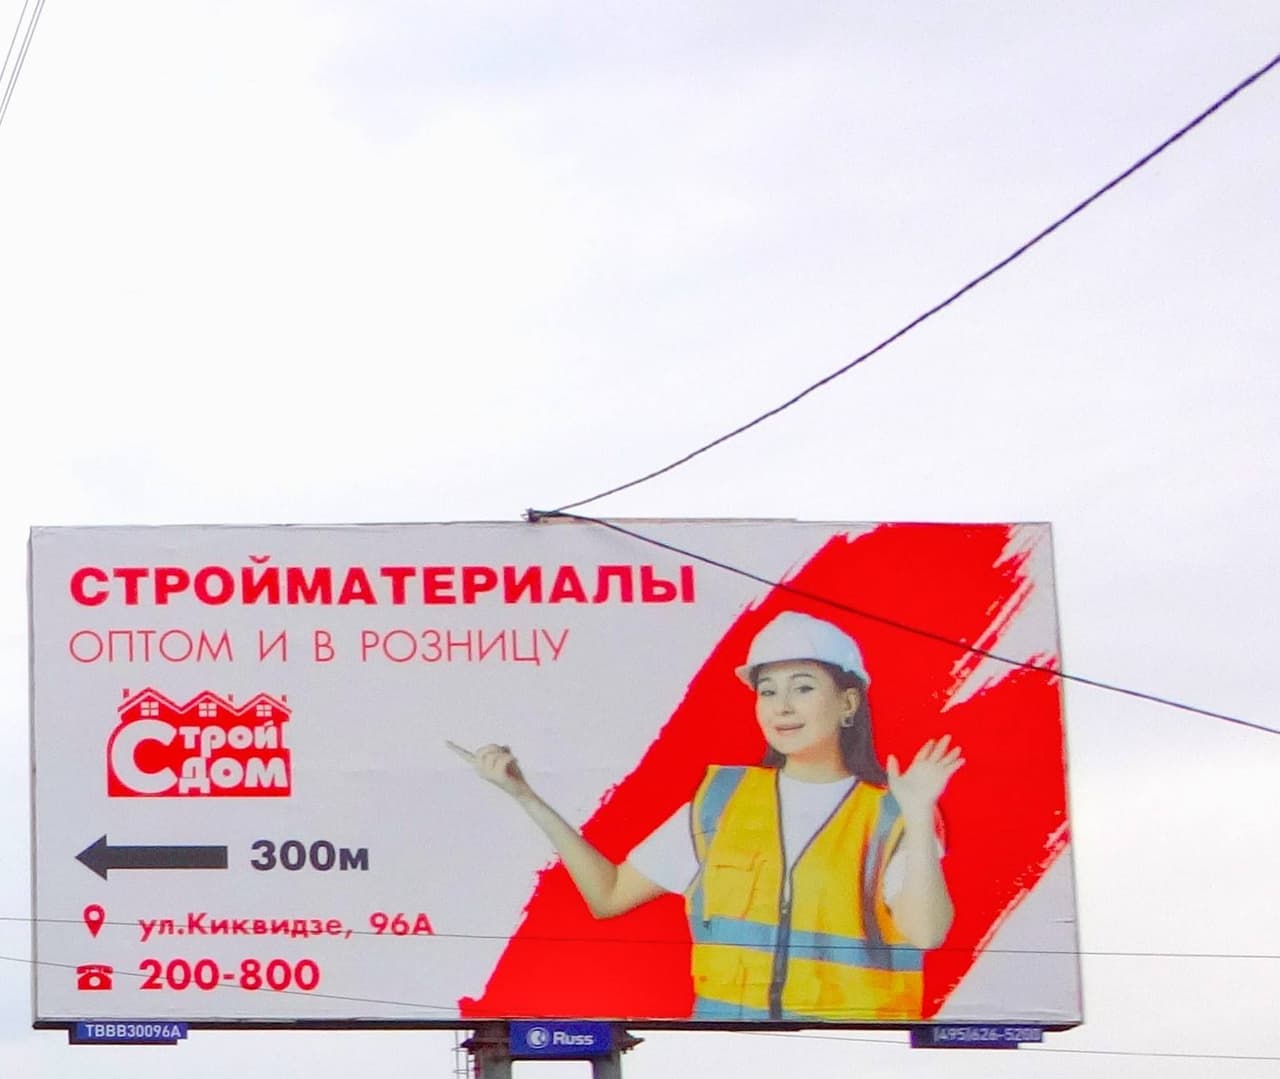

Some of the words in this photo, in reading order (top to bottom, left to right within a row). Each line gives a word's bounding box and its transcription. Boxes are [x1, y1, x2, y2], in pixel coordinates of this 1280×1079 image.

[69, 554, 695, 607] СТРОЙМАТЕРИАЛЫ
[68, 629, 234, 663] ОПТОМ
[259, 629, 287, 663] И
[314, 629, 335, 663] В
[360, 628, 570, 667] РОЗНИЦУ
[250, 839, 370, 872] 300м
[369, 912, 434, 936] 96А
[139, 958, 321, 991] 200-800
[552, 1031, 594, 1046] Russ
